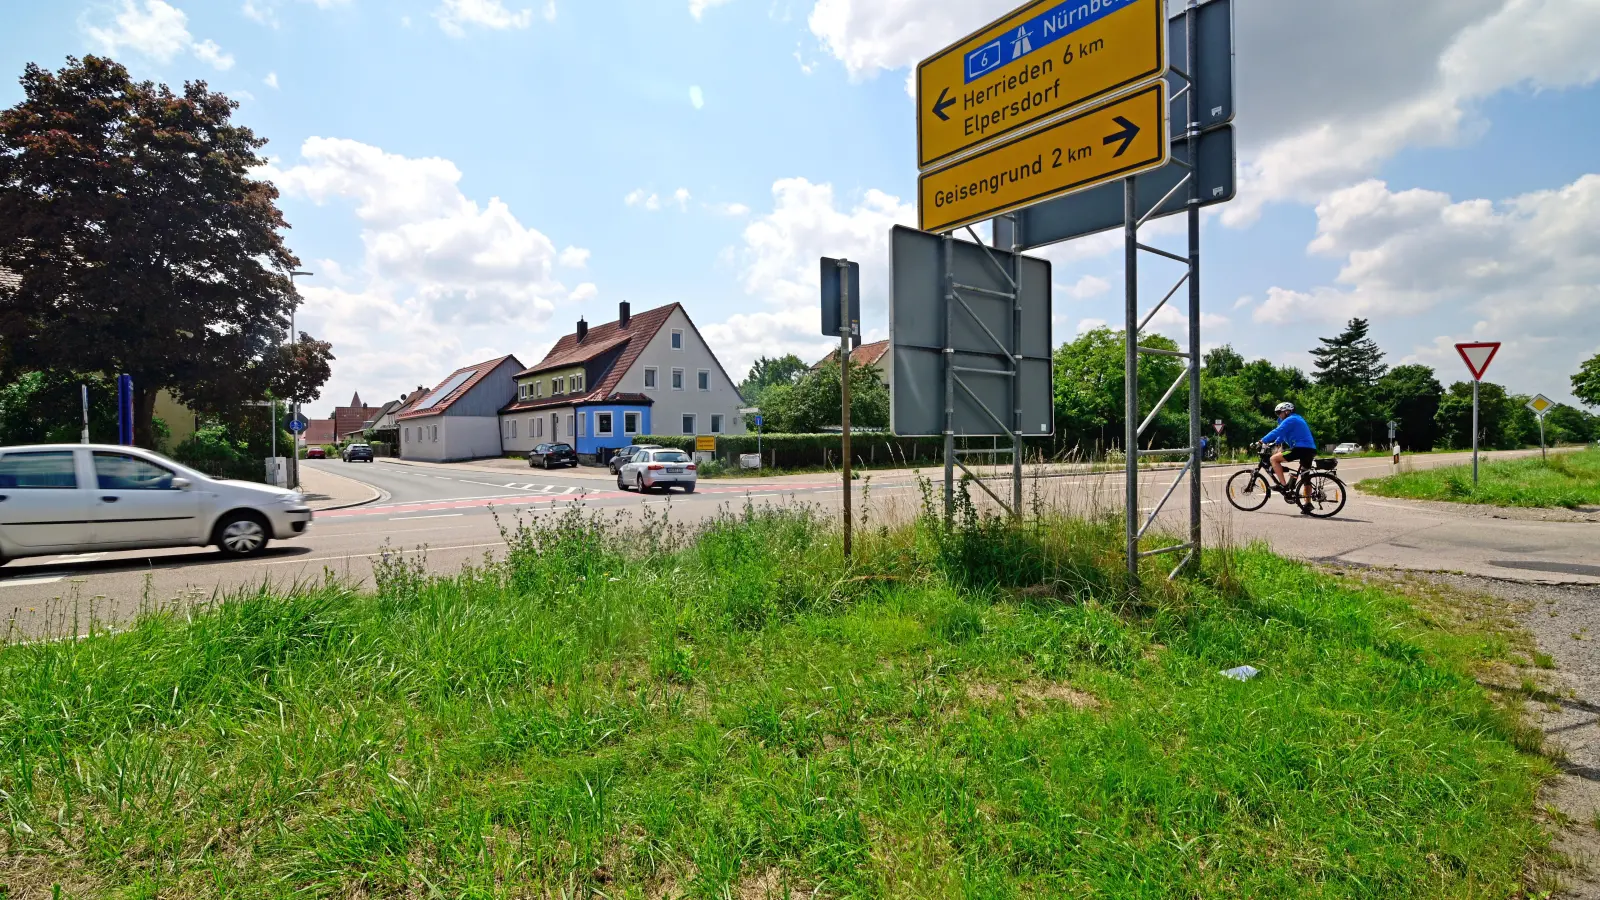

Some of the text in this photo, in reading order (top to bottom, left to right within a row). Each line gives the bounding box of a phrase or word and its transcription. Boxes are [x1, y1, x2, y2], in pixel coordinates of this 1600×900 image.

[964, 38, 1104, 111] Herrieden 6 km
[981, 53, 988, 67] 6
[964, 78, 1060, 136] Elpersdorf
[934, 145, 1092, 208] Geisengrund 2 km
